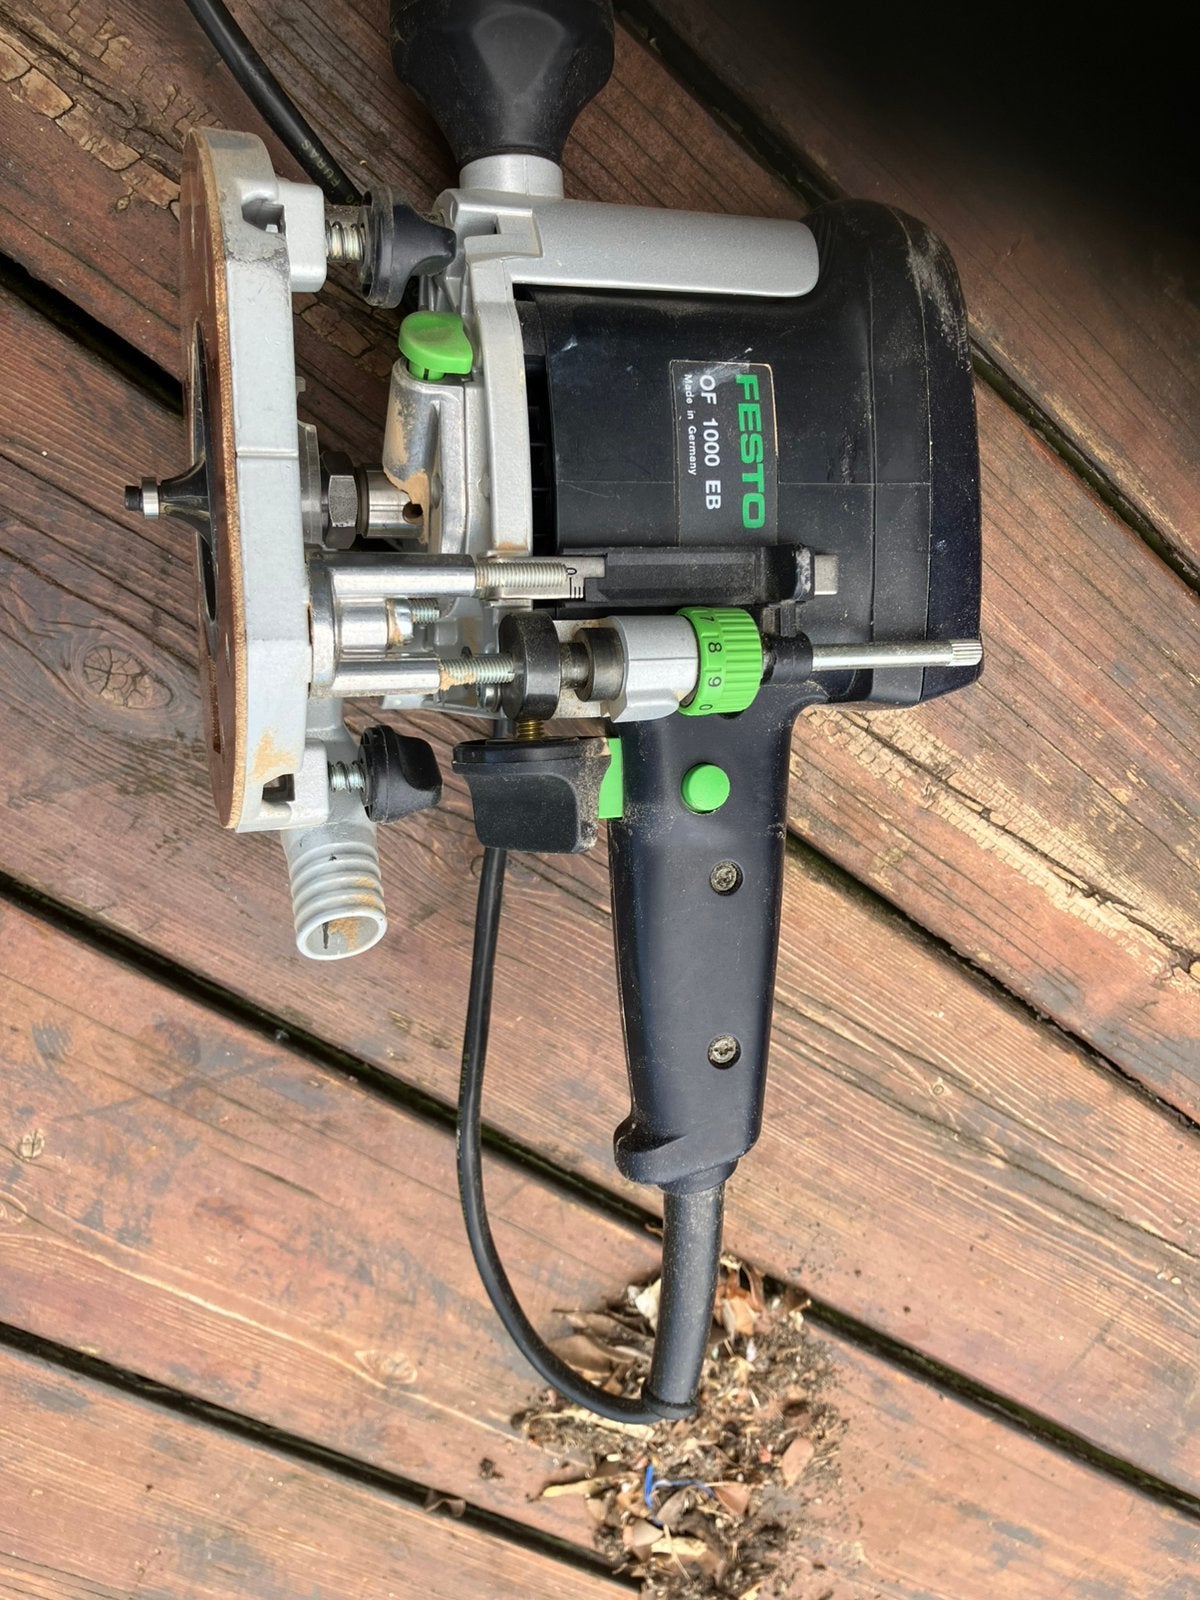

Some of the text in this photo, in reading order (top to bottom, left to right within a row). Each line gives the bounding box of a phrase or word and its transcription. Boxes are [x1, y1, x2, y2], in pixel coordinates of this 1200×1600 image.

[684, 373, 697, 476] Made in Germany
[700, 374, 721, 510] OF 1000 EB
[735, 374, 765, 528] FESTO
[708, 642, 722, 653] 8
[699, 703, 713, 711] 0
[708, 676, 722, 688] 9
